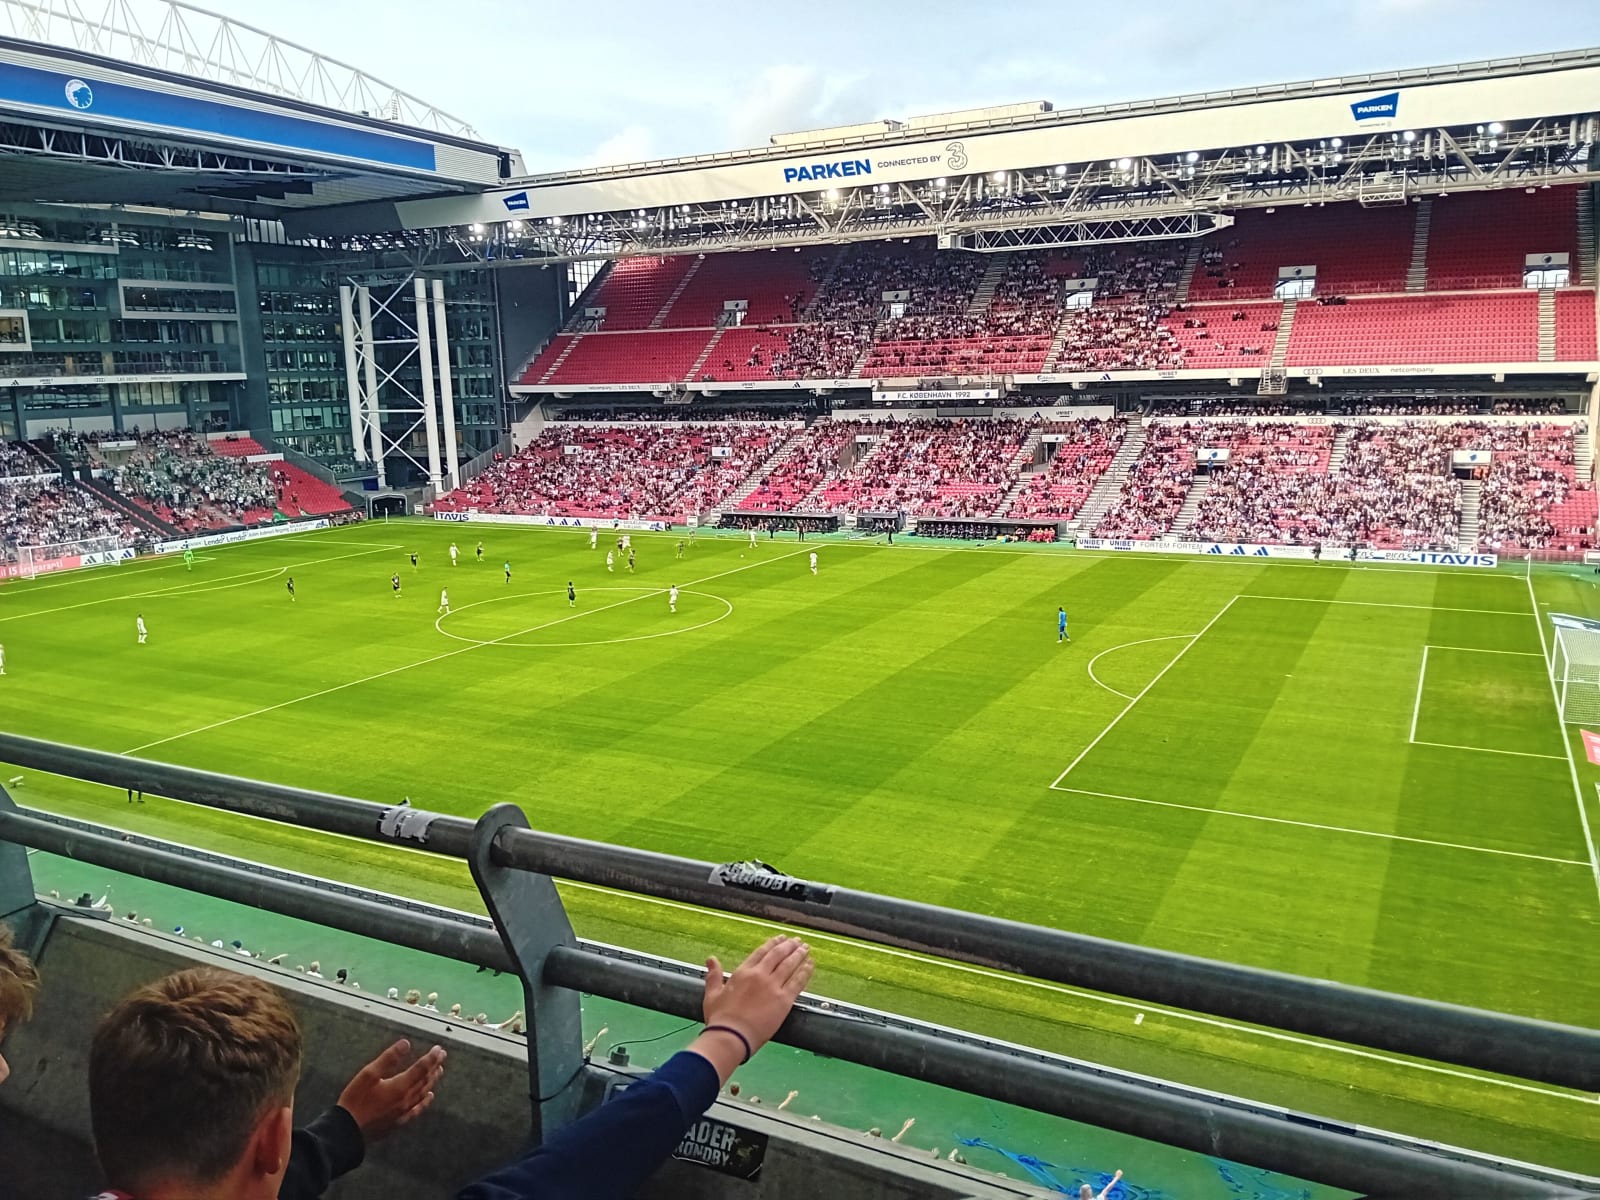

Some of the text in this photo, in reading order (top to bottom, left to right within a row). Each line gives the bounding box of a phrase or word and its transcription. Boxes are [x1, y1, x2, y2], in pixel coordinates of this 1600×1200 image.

[1357, 104, 1393, 113] PARKEN
[783, 141, 968, 183] PARKEN CONNECTED BY 3
[435, 511, 469, 521] ITAVIS
[1140, 541, 1169, 549] FORTEM
[1172, 542, 1203, 550] FORTEM
[1421, 553, 1494, 566] ITAVIS
